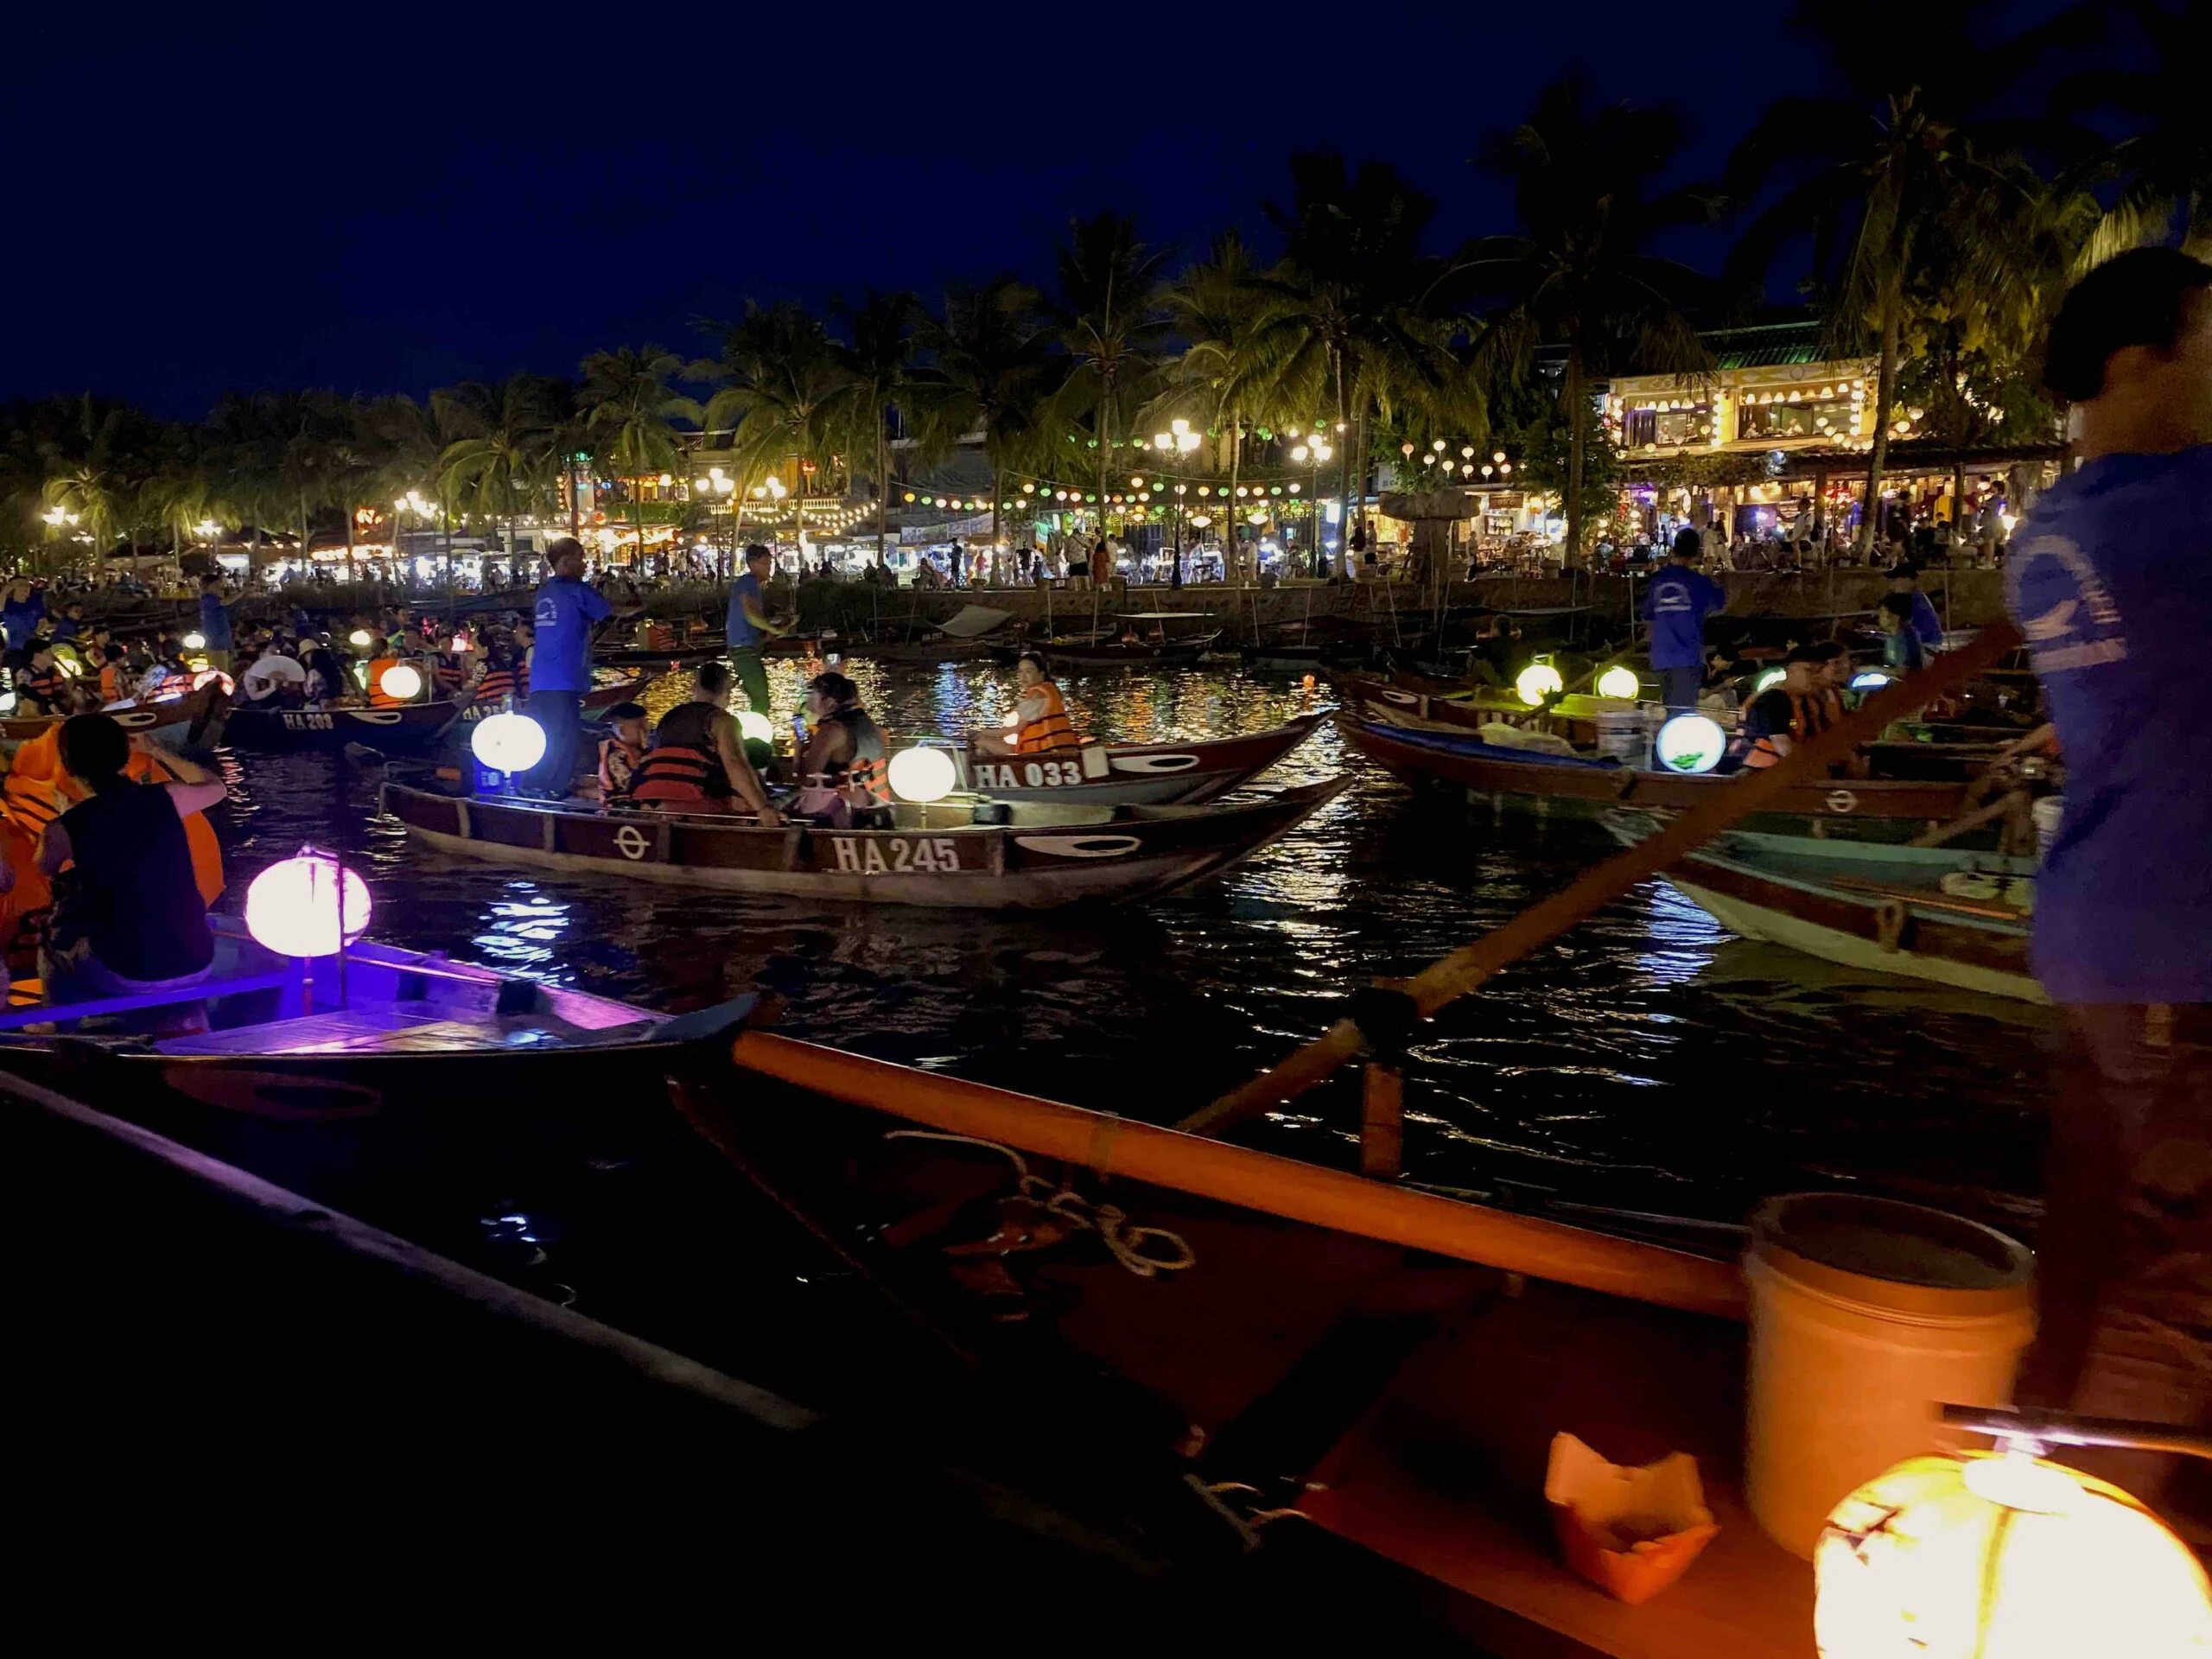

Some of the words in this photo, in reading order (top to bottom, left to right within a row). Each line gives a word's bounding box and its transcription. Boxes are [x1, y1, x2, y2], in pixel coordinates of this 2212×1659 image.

[283, 714, 306, 730] HA
[972, 765, 1021, 788] HA
[1024, 761, 1082, 787] 033
[831, 837, 889, 872] HA
[889, 837, 961, 873] 245
